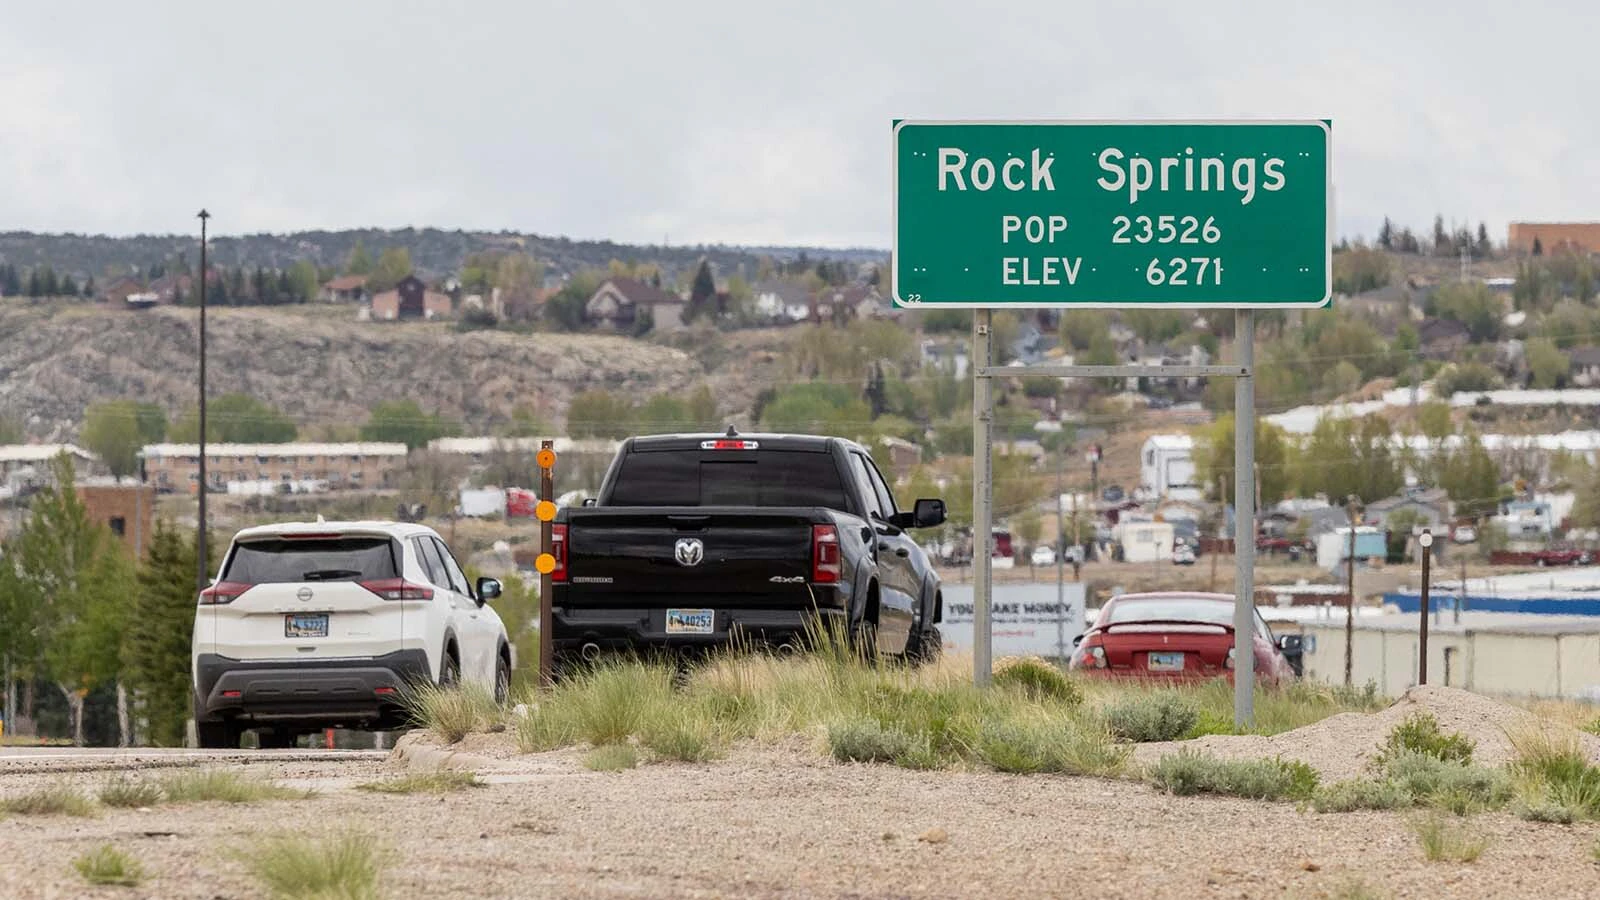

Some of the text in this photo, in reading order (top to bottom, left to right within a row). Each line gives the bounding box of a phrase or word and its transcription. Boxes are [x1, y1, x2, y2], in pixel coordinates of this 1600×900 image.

[938, 147, 1286, 205] Rock Springs
[1002, 215, 1221, 244] POP 23526
[1003, 257, 1224, 286] ELEV 6271
[907, 294, 921, 303] 22
